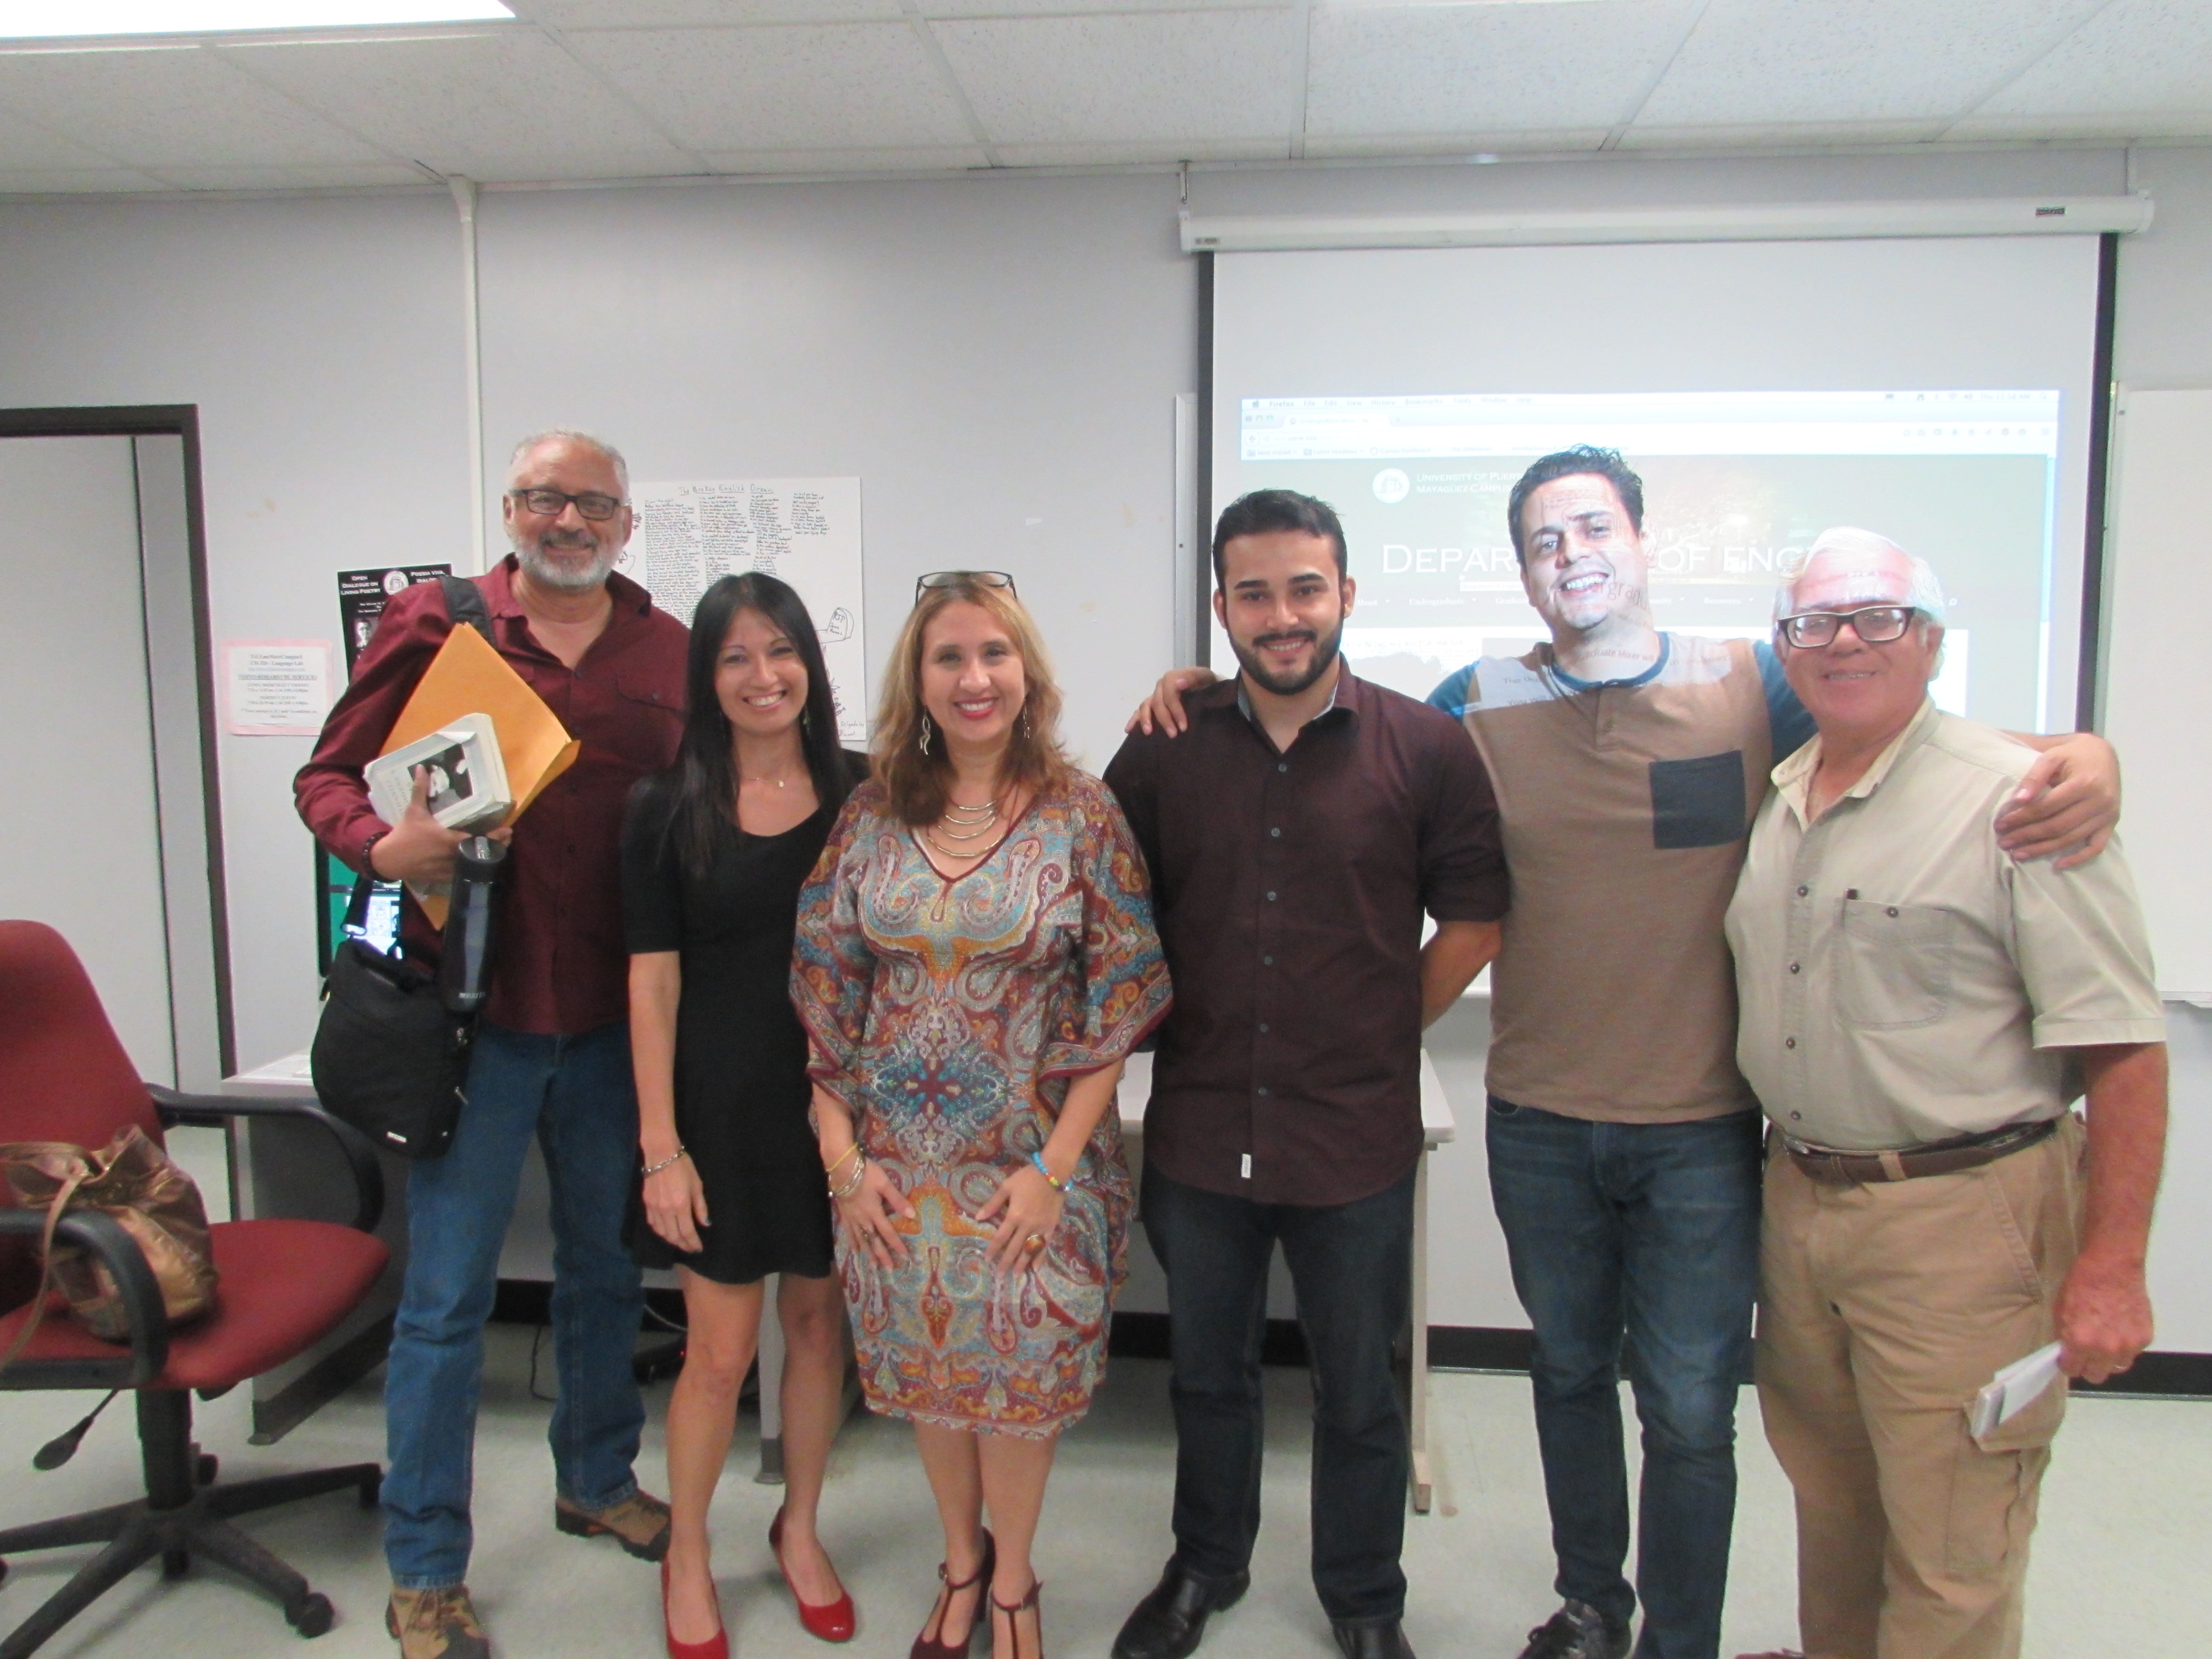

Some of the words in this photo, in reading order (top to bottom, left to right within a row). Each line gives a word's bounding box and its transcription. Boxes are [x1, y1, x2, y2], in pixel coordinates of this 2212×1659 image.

[1269, 400, 1295, 408] Firefox
[1371, 399, 1396, 407] History
[1516, 396, 1531, 405] Help
[1417, 473, 1472, 482] UNIVERSITY
[1490, 472, 1522, 481] PUERT
[719, 483, 745, 492] English
[750, 483, 774, 493] Dream
[1382, 544, 1514, 574] DEPAR
[1658, 546, 1712, 573] OF
[1355, 597, 1378, 607] About
[1408, 597, 1465, 608] Undergraduate
